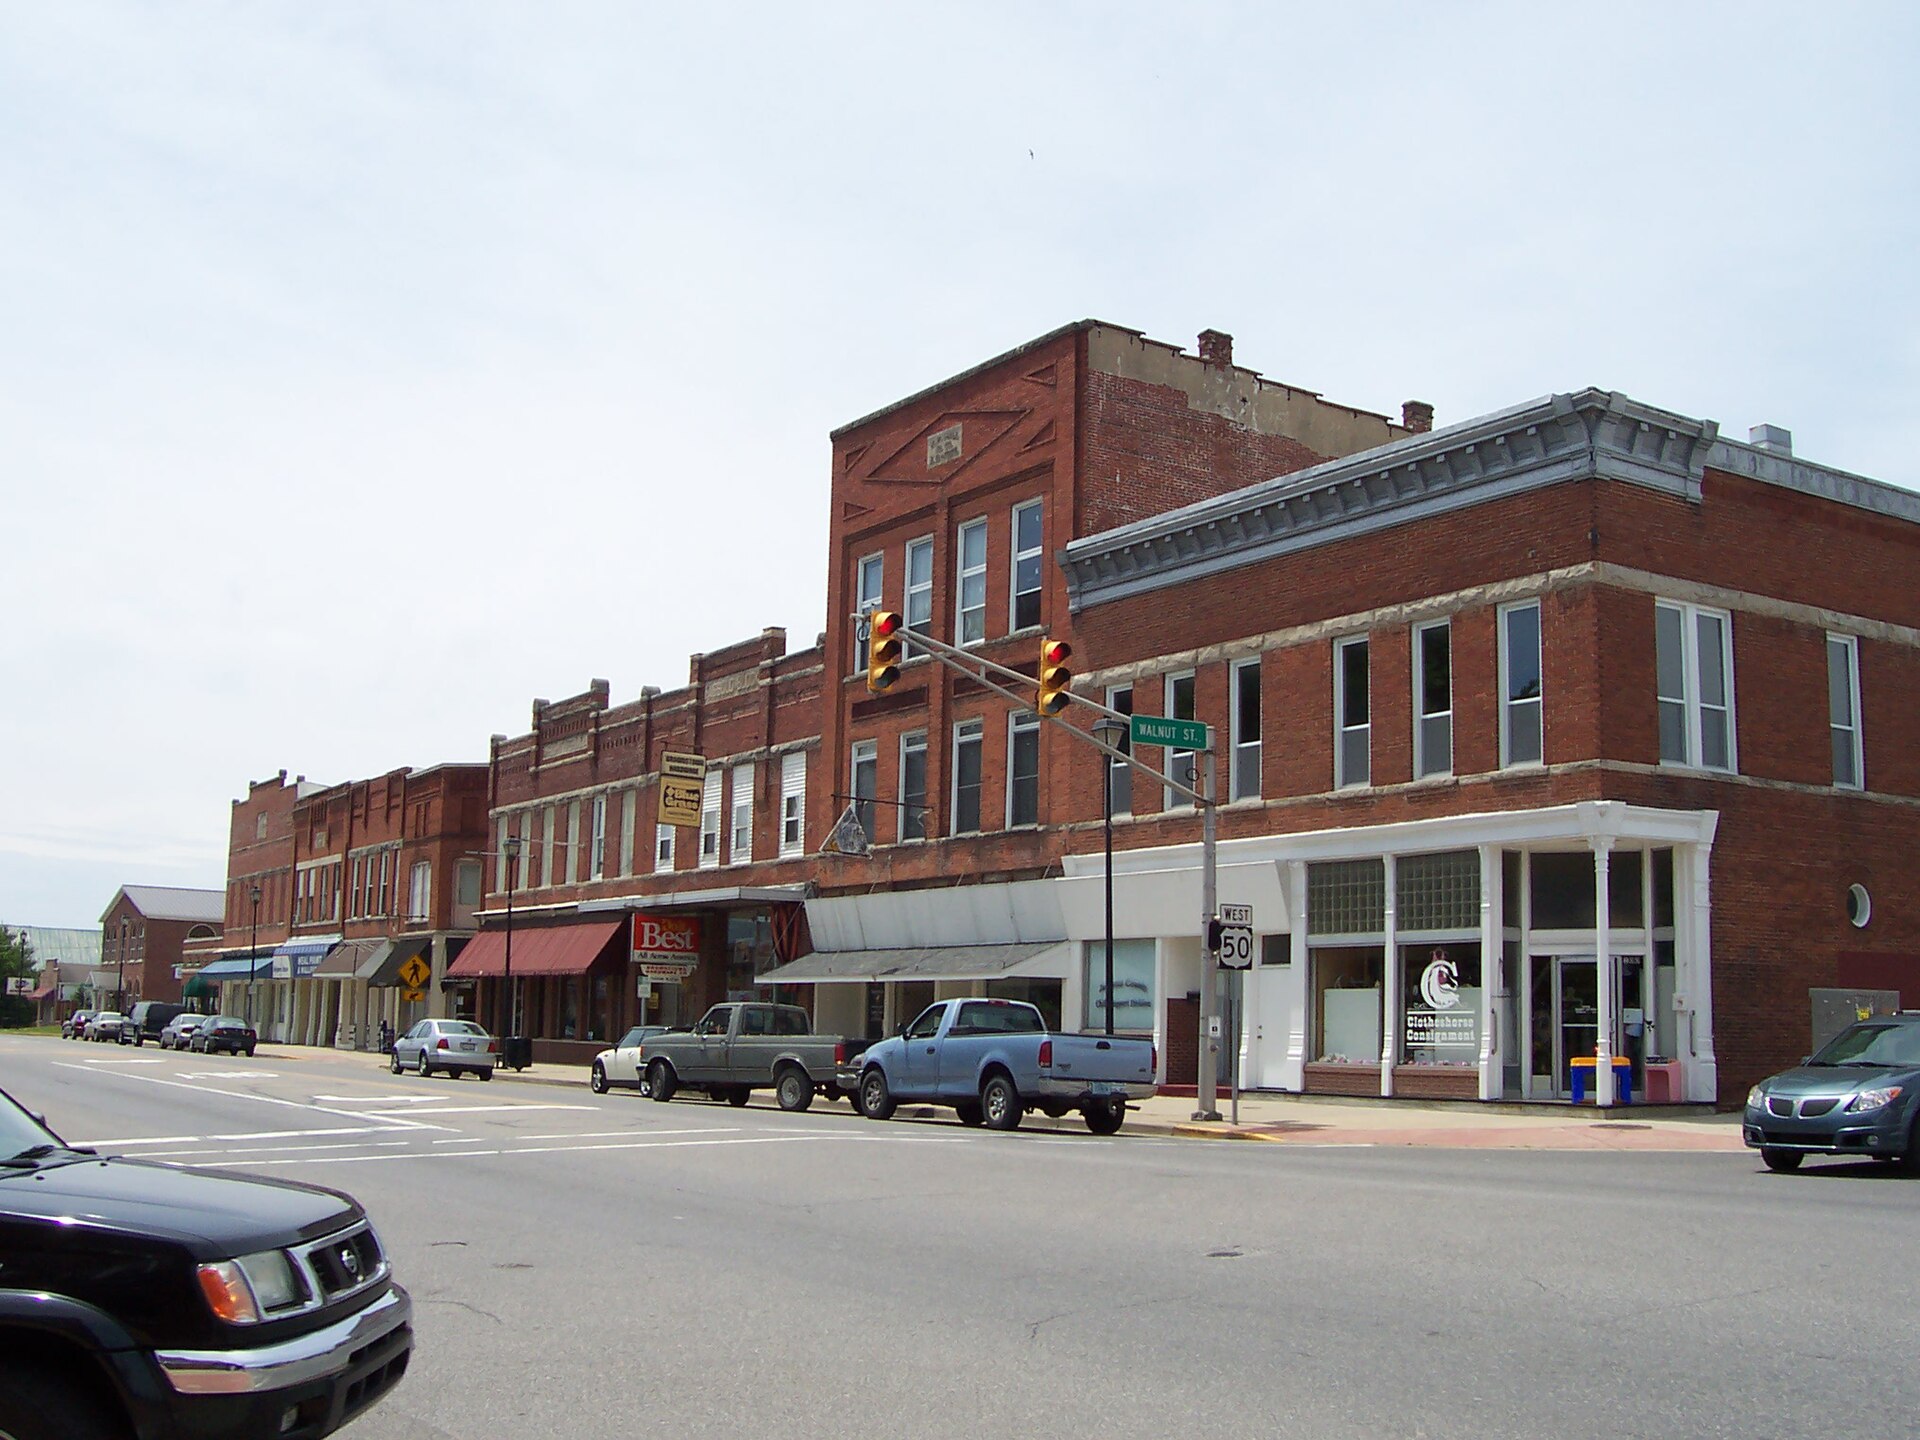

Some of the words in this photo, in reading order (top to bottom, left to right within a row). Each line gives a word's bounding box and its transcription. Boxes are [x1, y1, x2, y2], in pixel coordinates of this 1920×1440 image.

[1139, 723, 1177, 739] WALNUT
[674, 788, 700, 801] Blue
[665, 796, 699, 810] Grass
[1223, 908, 1249, 921] WEST
[640, 921, 695, 950] Best
[1223, 936, 1249, 958] 50
[1407, 1016, 1474, 1028] Clotheshorse
[1406, 1029, 1475, 1043] Consignment
